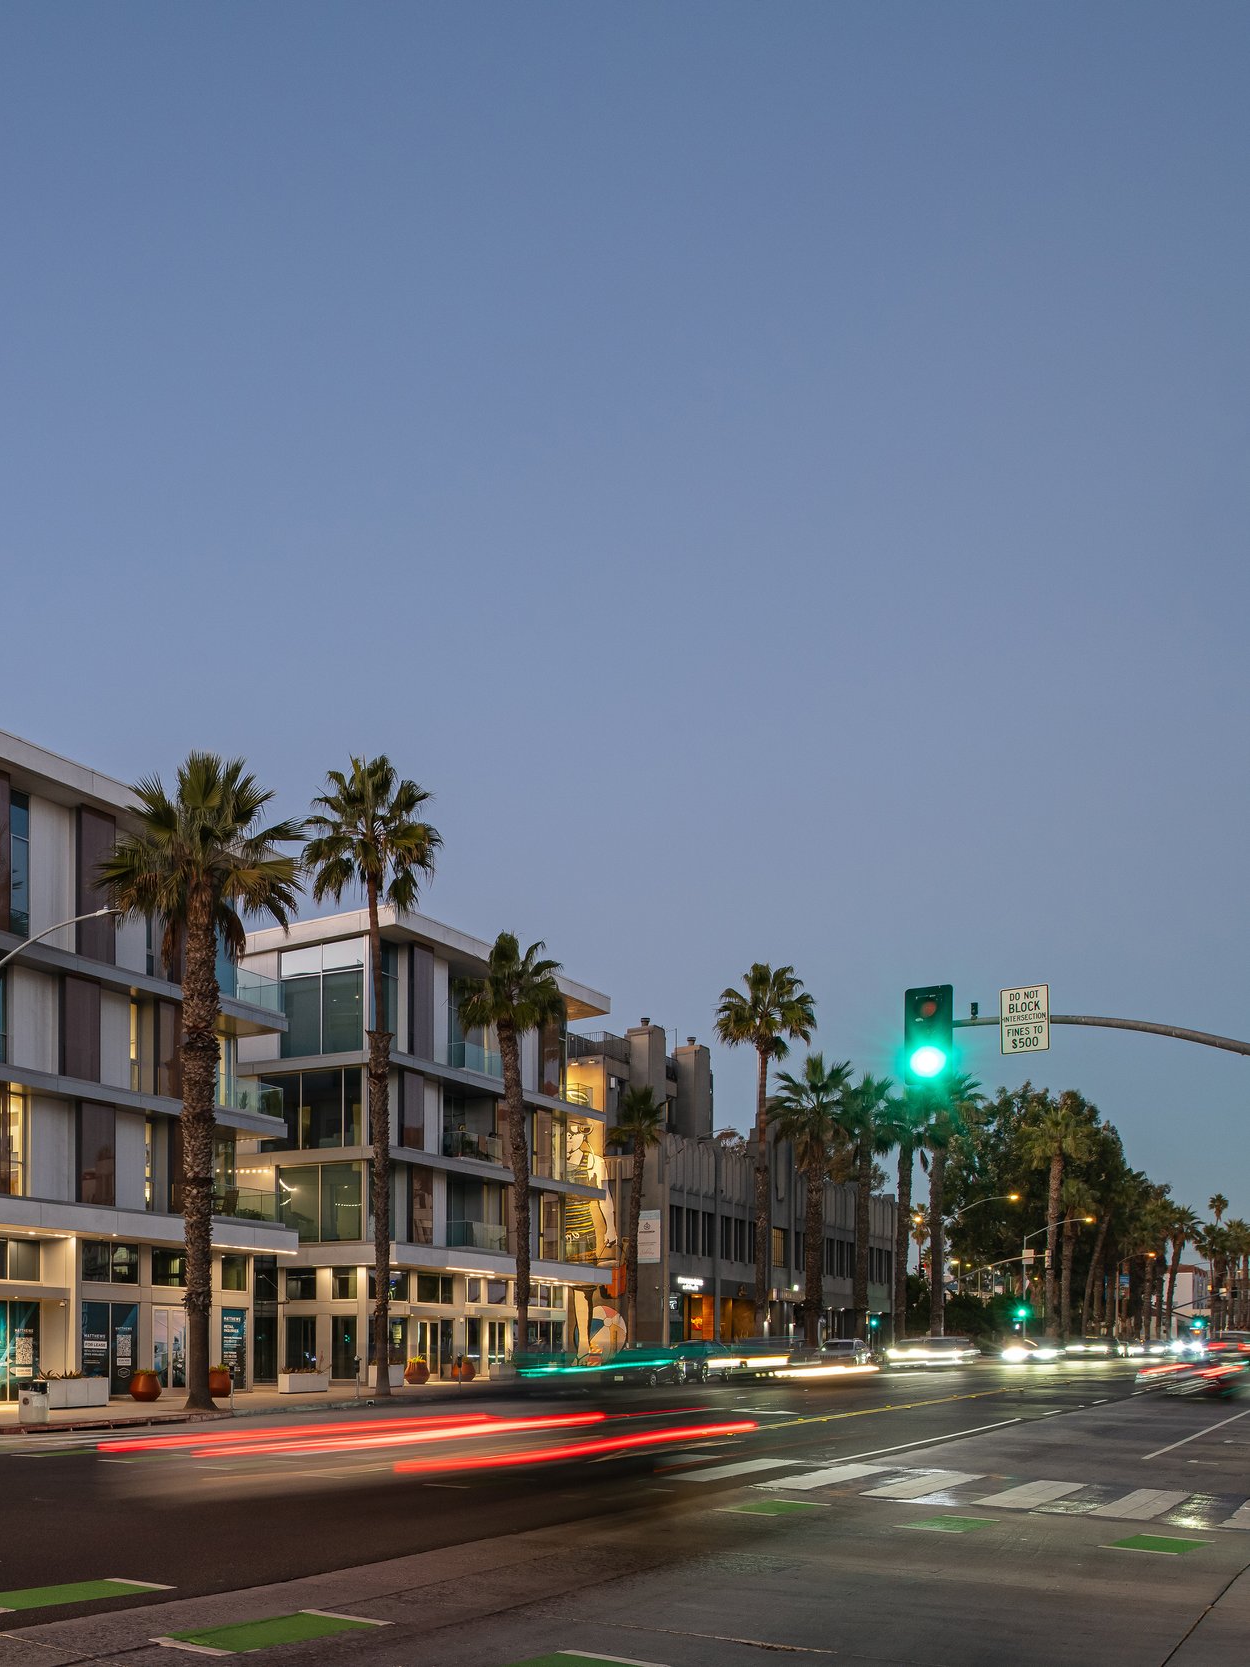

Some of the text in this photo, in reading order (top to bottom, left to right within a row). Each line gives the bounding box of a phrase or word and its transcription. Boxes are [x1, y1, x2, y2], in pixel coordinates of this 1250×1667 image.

[1010, 990, 1038, 1001] DO NOT
[1008, 1000, 1040, 1014] BLOCK
[1004, 1012, 1046, 1022] INTERSECTION
[1007, 1026, 1043, 1037] FINES TO
[1012, 1036, 1038, 1049] $500
